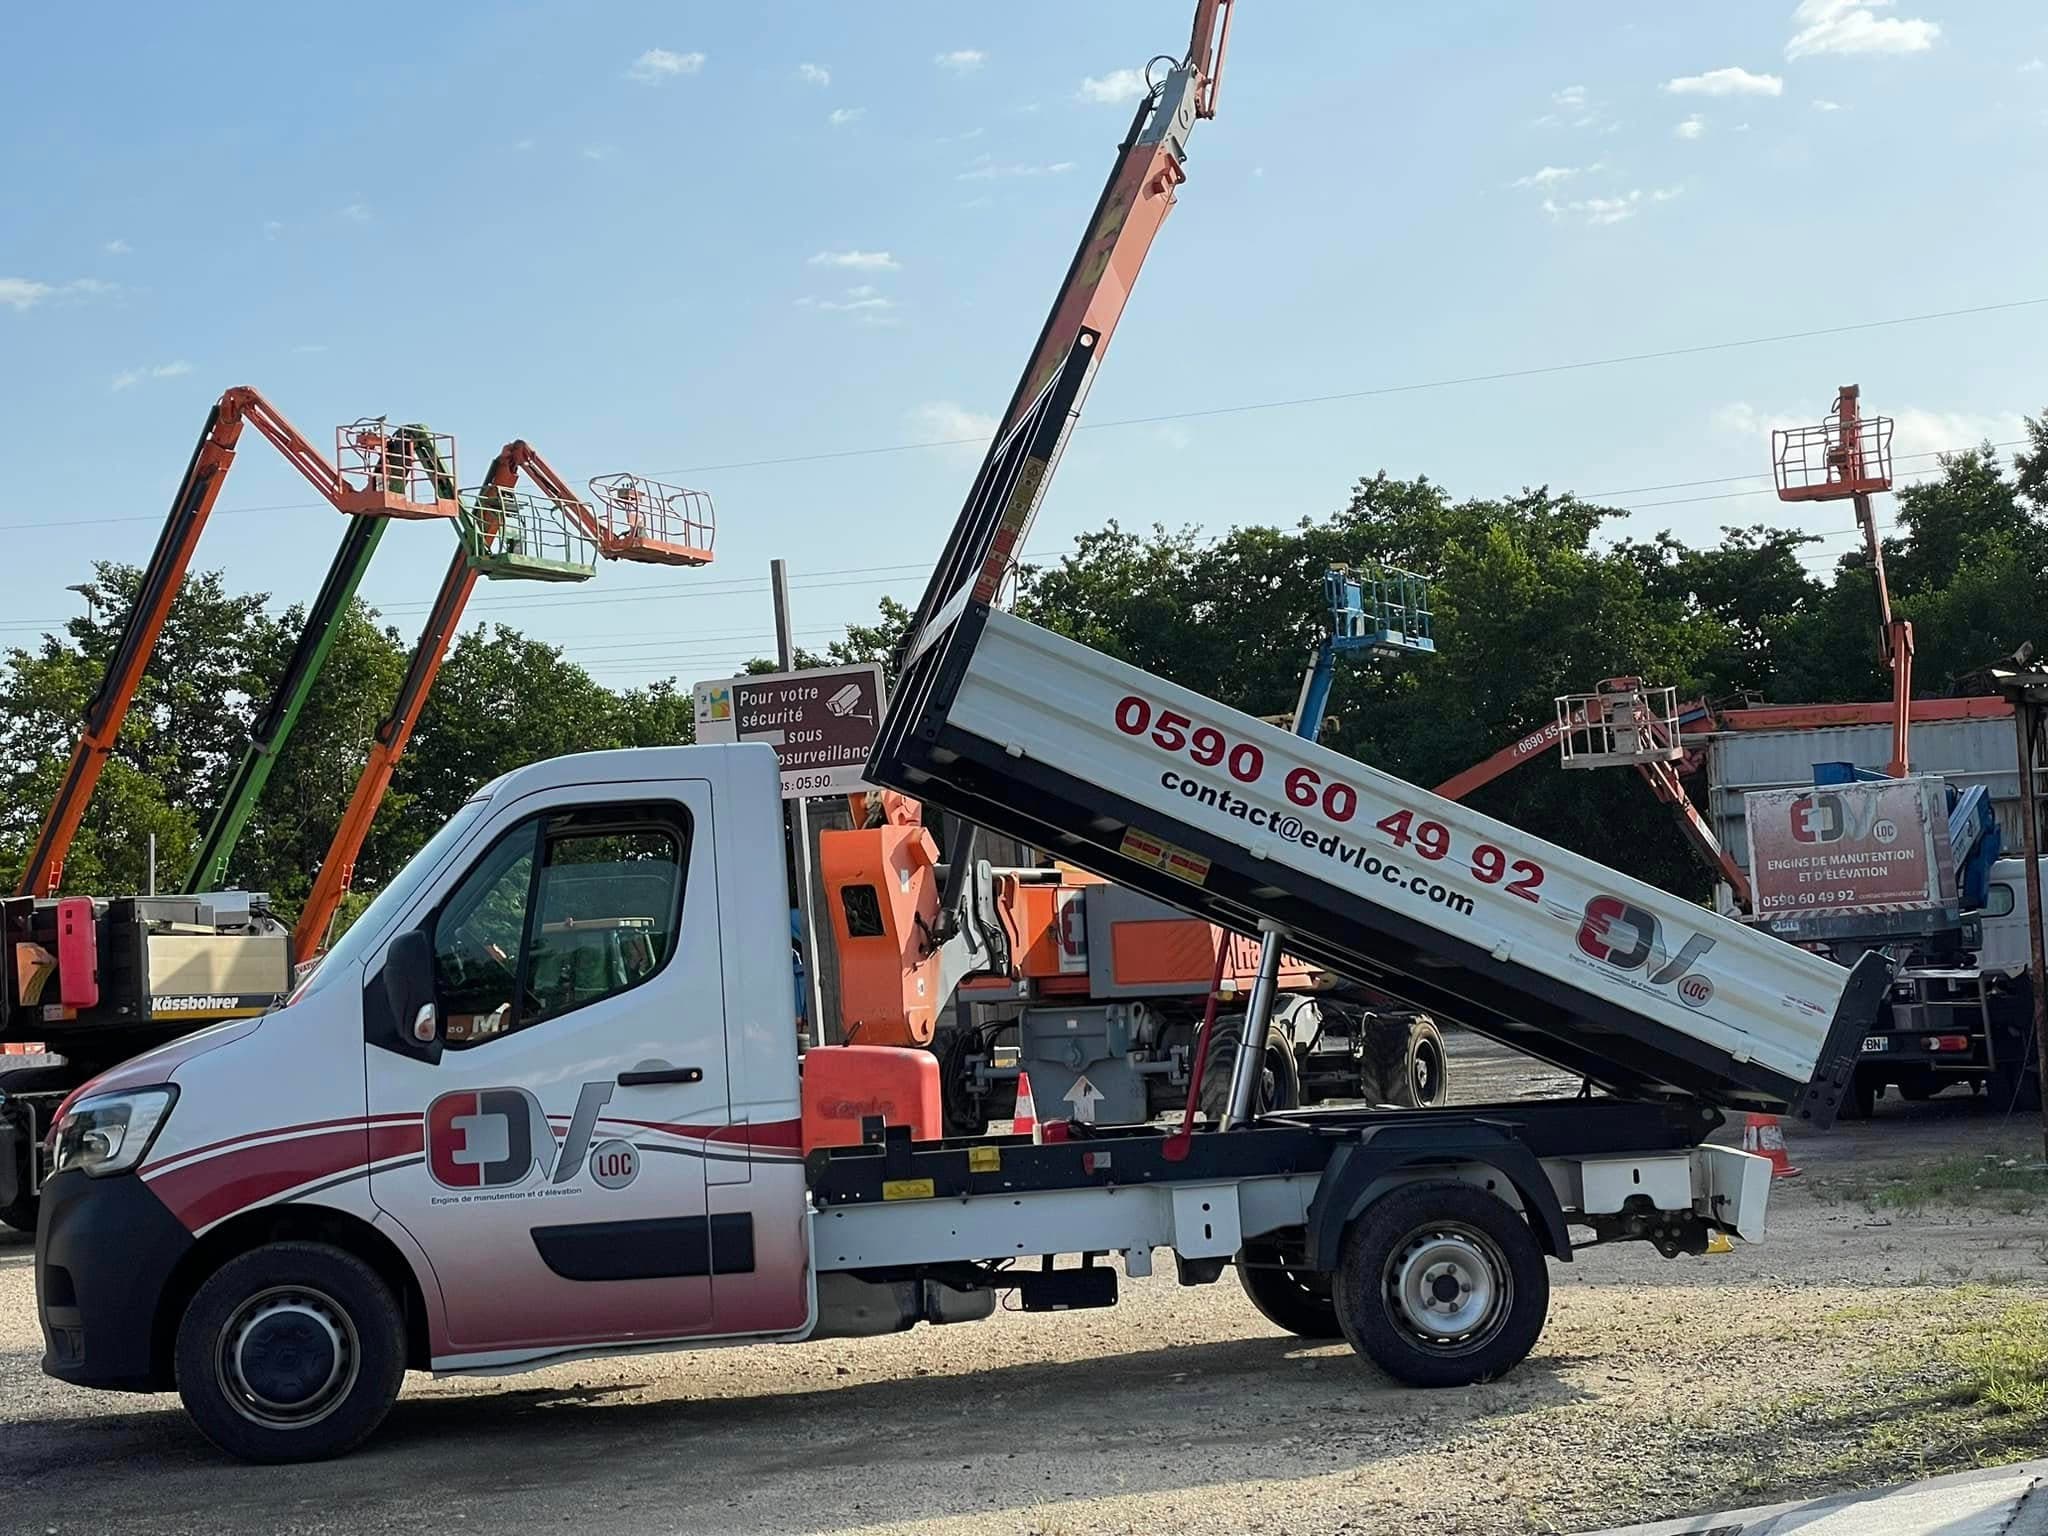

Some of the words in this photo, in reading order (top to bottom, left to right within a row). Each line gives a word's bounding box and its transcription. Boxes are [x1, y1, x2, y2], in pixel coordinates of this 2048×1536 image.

[740, 690, 774, 707] Pour
[780, 687, 819, 702] votre
[742, 708, 803, 727] sécurité
[789, 729, 823, 744] sous
[1518, 733, 1544, 753] 0690
[1544, 725, 1559, 739] 55
[1115, 696, 1264, 784] 0590
[1285, 767, 1357, 823] 60
[1377, 809, 1450, 862] 49
[1471, 844, 1545, 904] 92
[1160, 770, 1475, 917] contact@edvloc.com
[1768, 857, 1810, 870] ENGINS
[1812, 856, 1827, 867] DE
[1829, 849, 1914, 865] MANUTENTION
[1799, 872, 1812, 882] ET
[1799, 892, 1815, 905] 60
[1818, 891, 1835, 903] 49
[1838, 889, 1855, 902] 92
[1683, 980, 1710, 1001] LOC
[151, 996, 239, 1012] Kässbohrer
[598, 1152, 632, 1177] LOC
[431, 1196, 459, 1206] Engins
[461, 1194, 472, 1203] de
[473, 1191, 526, 1202] manutention
[527, 1190, 536, 1199] et
